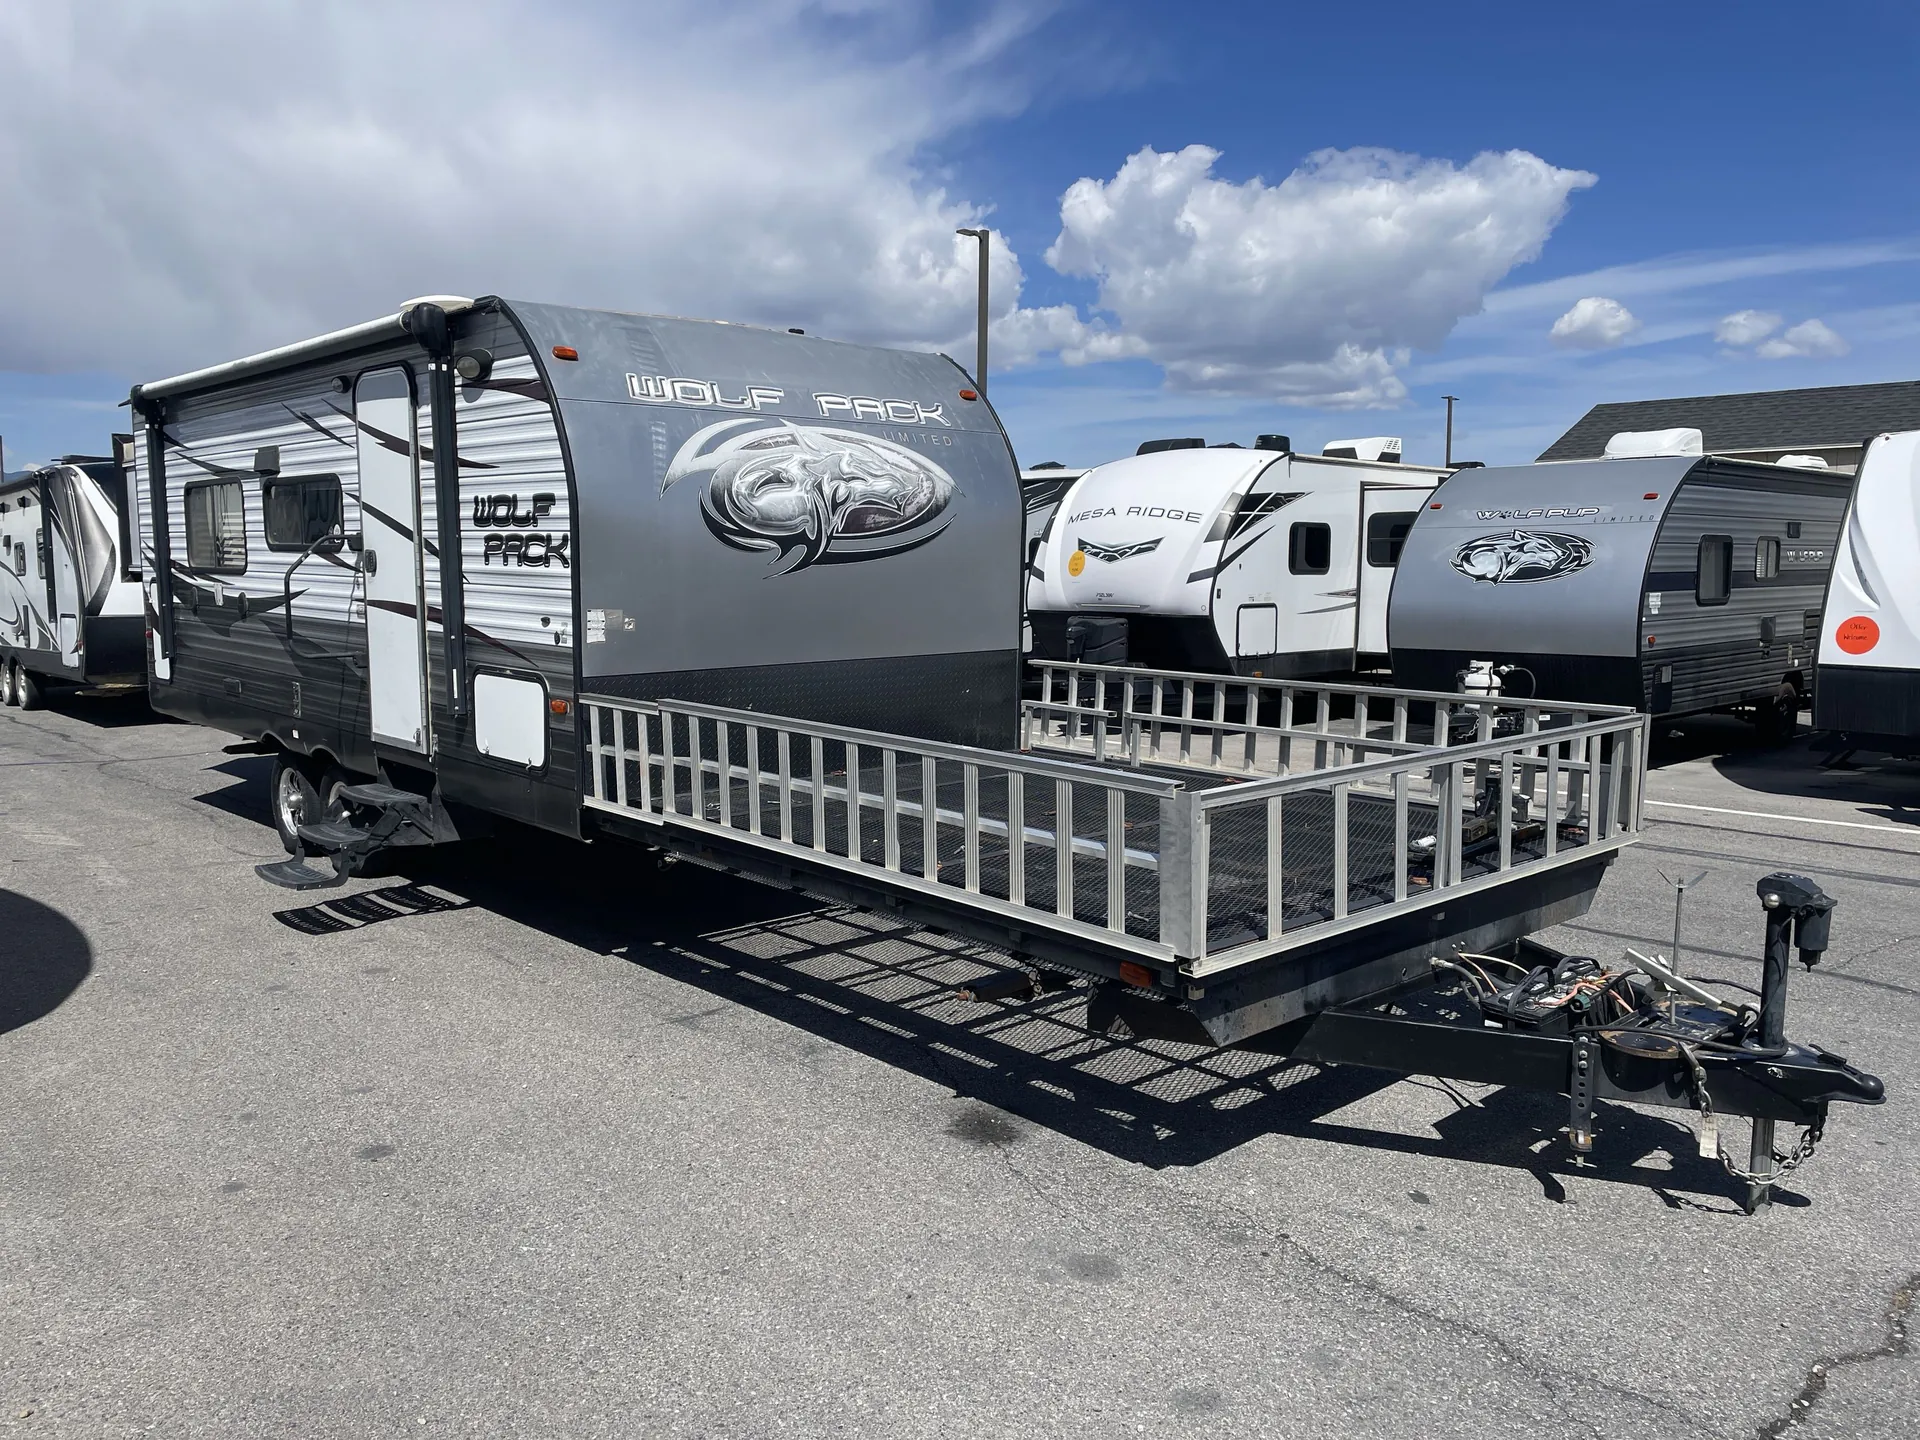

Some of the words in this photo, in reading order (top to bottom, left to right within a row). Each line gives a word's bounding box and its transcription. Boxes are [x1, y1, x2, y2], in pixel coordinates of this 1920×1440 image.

[626, 373, 784, 410] WOLF
[813, 392, 951, 427] PACK
[883, 430, 952, 447] LIMITED
[473, 492, 556, 527] WOLF
[1067, 507, 1116, 525] MESA
[1126, 506, 1204, 524] RIDGE
[1545, 507, 1600, 518] PUP
[1593, 514, 1655, 523] LIMITED
[484, 533, 570, 568] PACK
